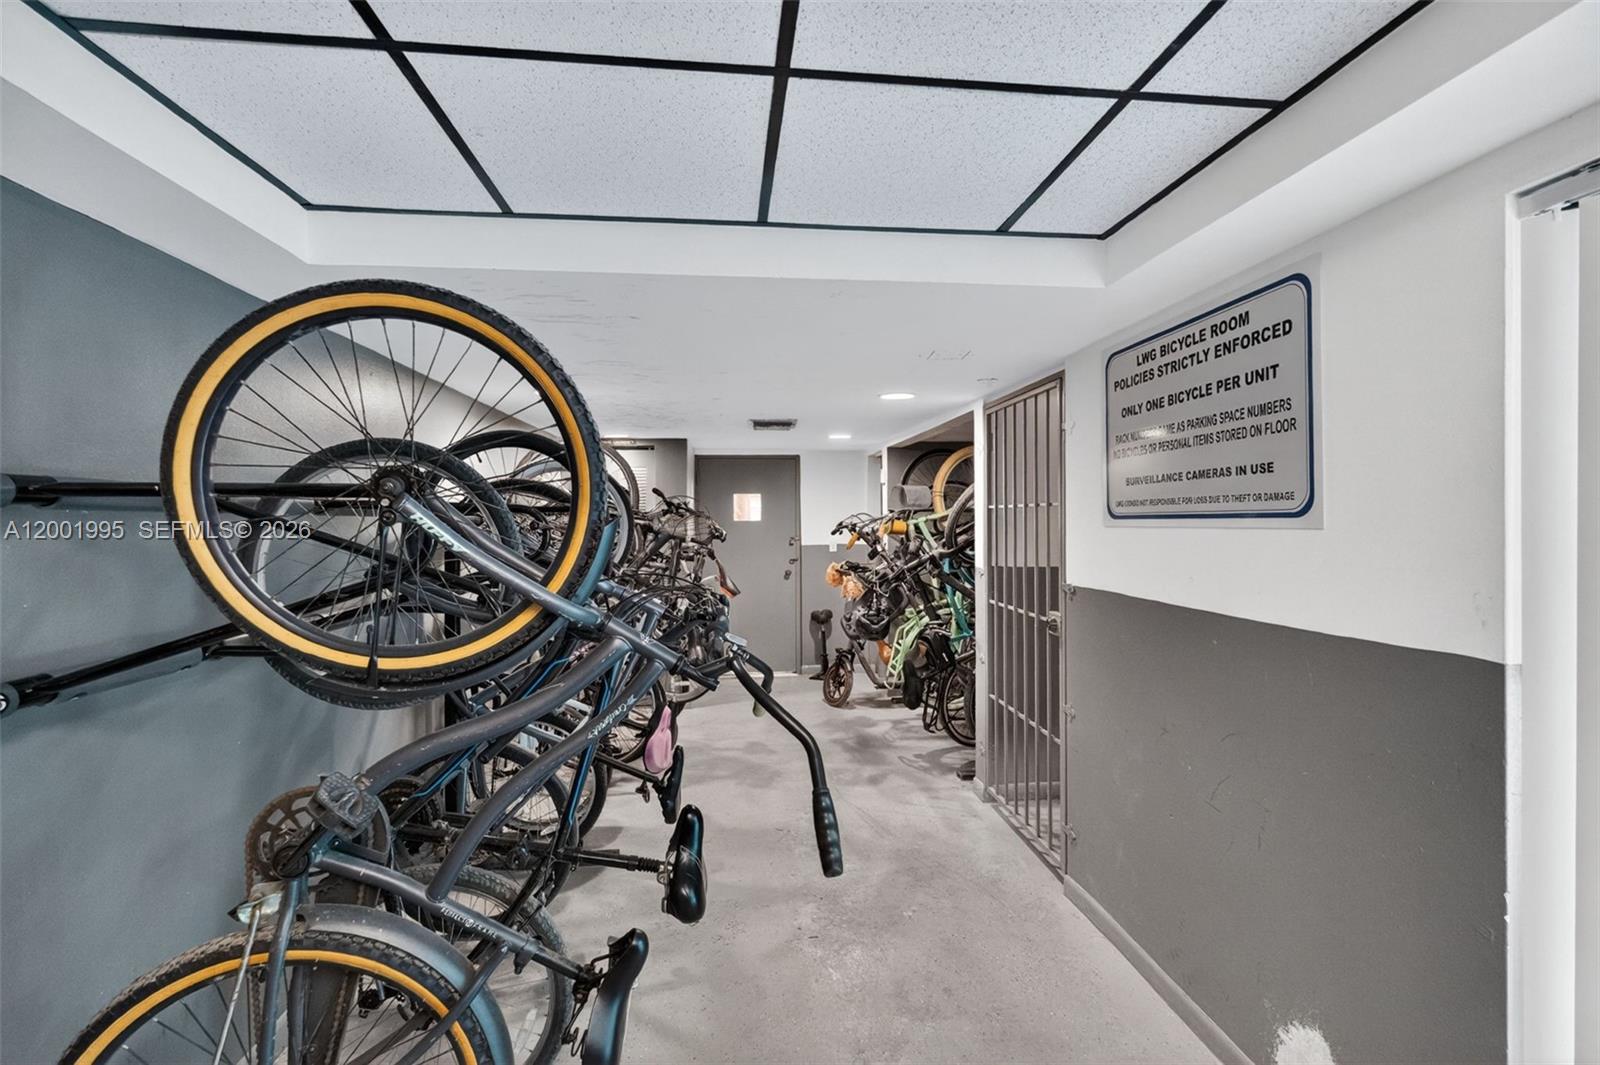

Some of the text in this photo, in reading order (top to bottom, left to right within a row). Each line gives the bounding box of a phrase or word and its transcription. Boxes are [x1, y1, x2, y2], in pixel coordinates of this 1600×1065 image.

[1113, 319, 1293, 392] POLICIES STRICTLY ENFORCED
[1136, 310, 1250, 366] LWG BICYCLE ROOM
[1121, 363, 1280, 418] ONLY ONE BICYCLE PER UNIT
[1176, 420, 1186, 433] AS
[1186, 413, 1218, 431] PARKING
[1219, 407, 1245, 424] SPACE
[1247, 397, 1292, 418] NUMBERS
[1193, 432, 1215, 447] ITEMS
[1215, 426, 1248, 443] STORED
[1249, 424, 1262, 439] ON
[1264, 417, 1297, 435] FLOOR
[1125, 461, 1274, 486] SURVEILLANCE CAMERAS IN USE
[1231, 493, 1251, 503] THEFT
[1252, 493, 1263, 502] OR
[1264, 491, 1296, 502] DAMAGE
